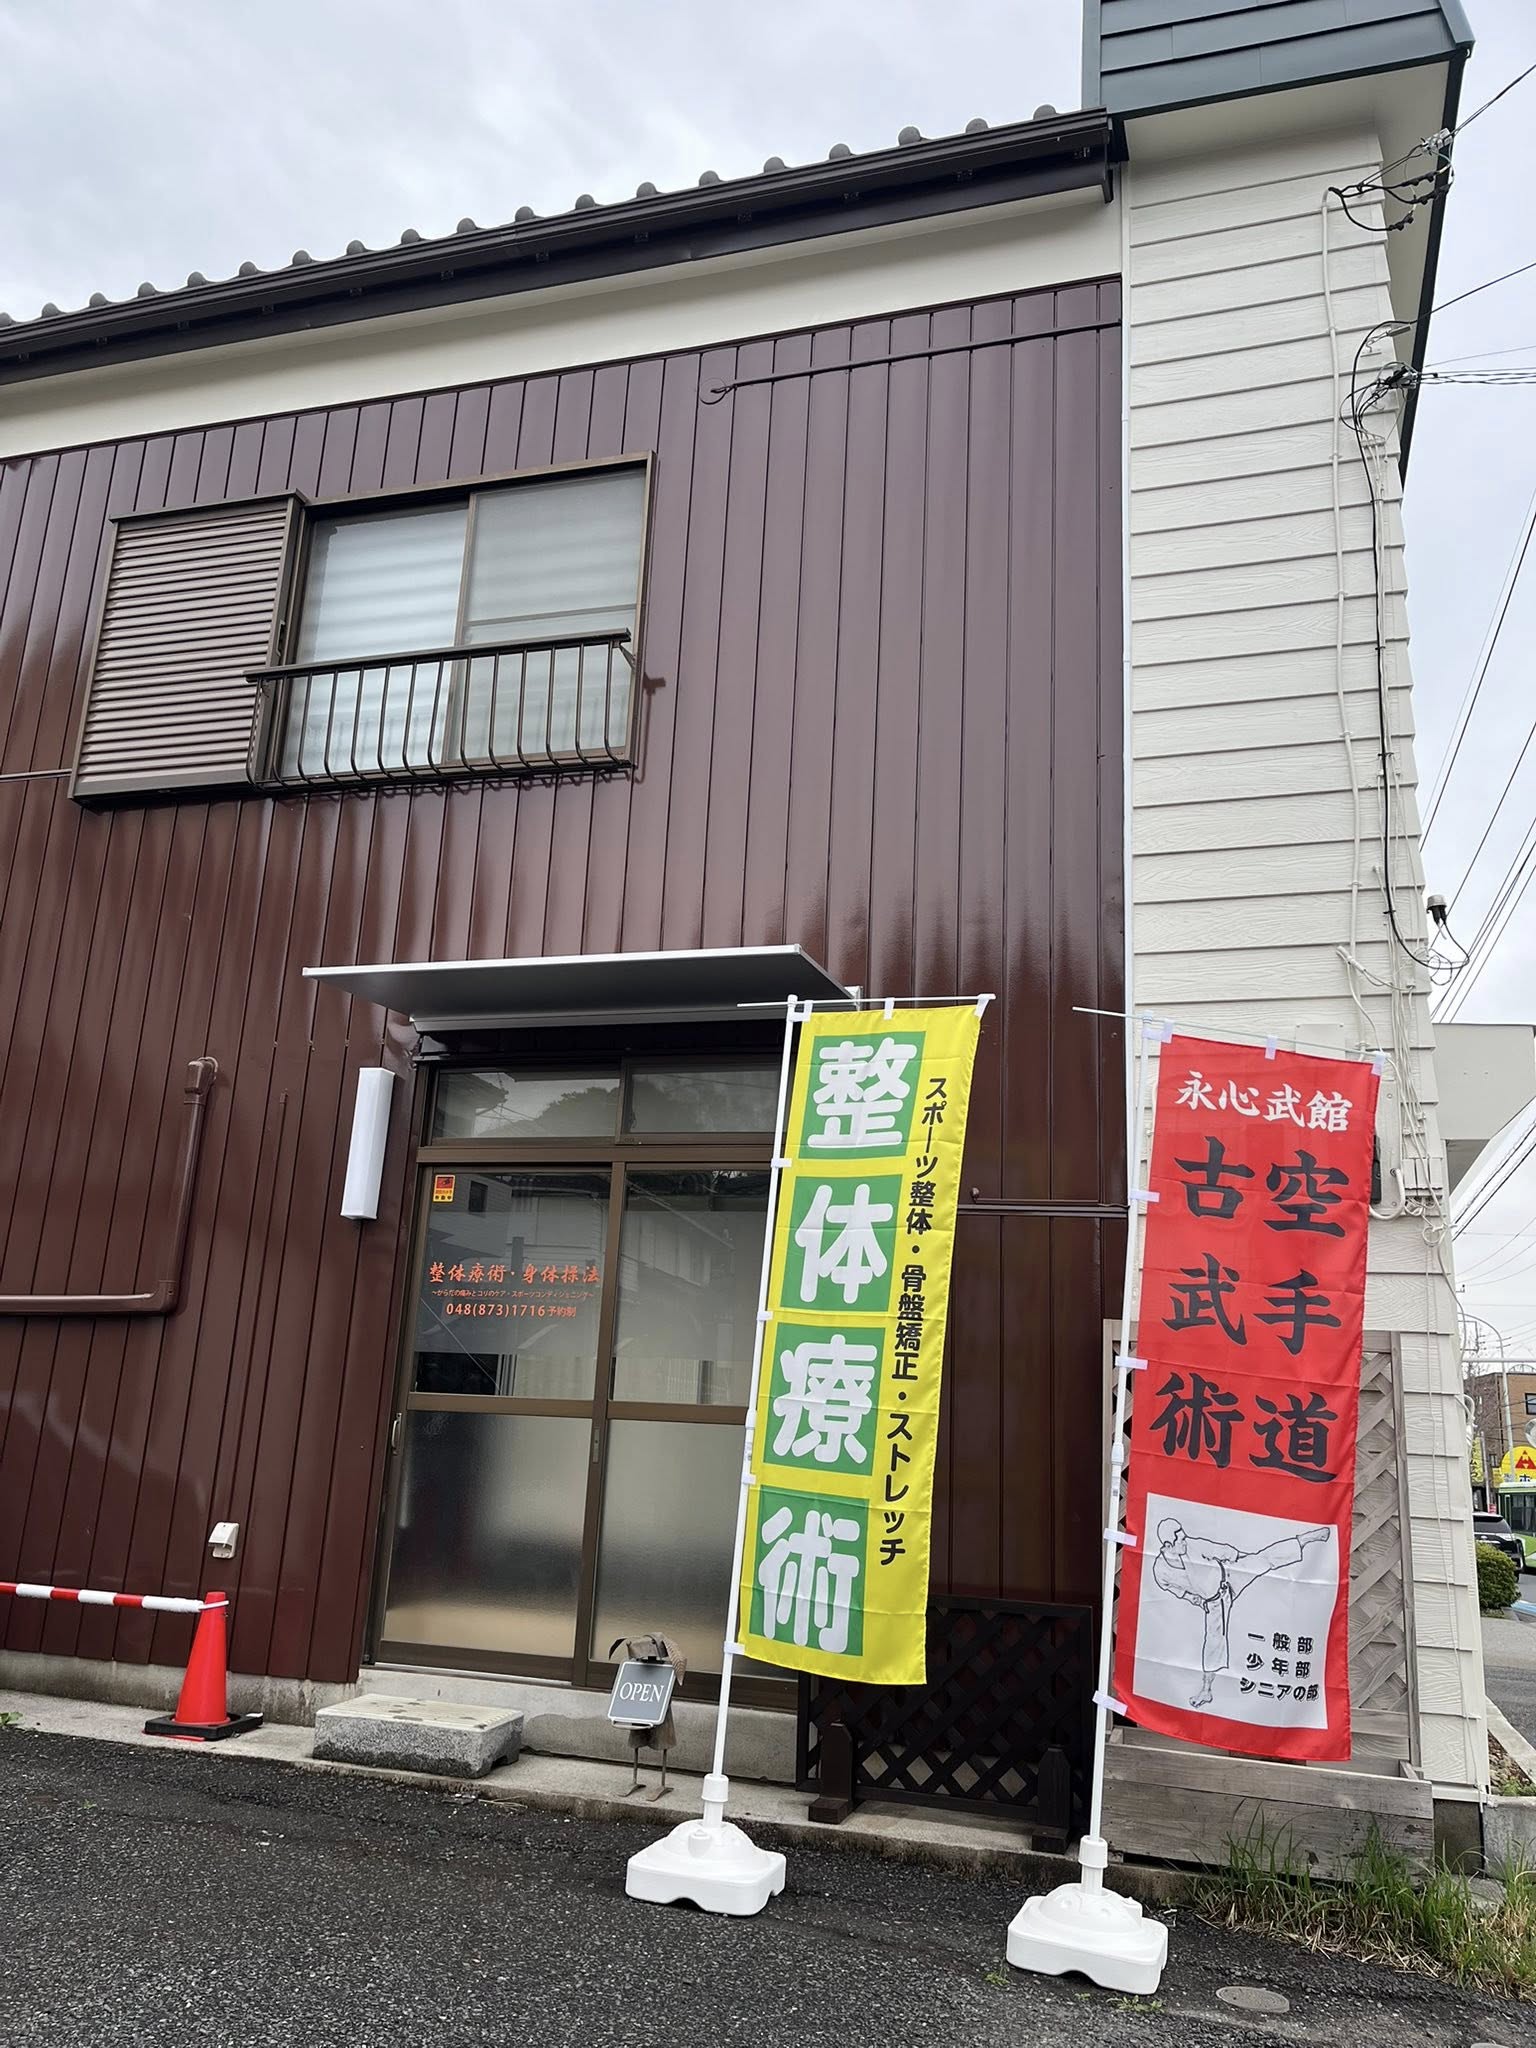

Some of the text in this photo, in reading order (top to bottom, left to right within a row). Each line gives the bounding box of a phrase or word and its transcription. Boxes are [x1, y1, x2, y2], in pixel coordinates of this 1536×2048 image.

[1175, 1070, 1353, 1133] 永心武館
[1149, 1135, 1255, 1469] 古武術
[1249, 1149, 1350, 1483] 空手道
[759, 1037, 917, 1654] 整体療術
[1247, 1632, 1314, 1654] 一般部
[1246, 1653, 1311, 1678] 少年部
[619, 1682, 664, 1702] OPEN
[1239, 1677, 1320, 1702] シニアの部
